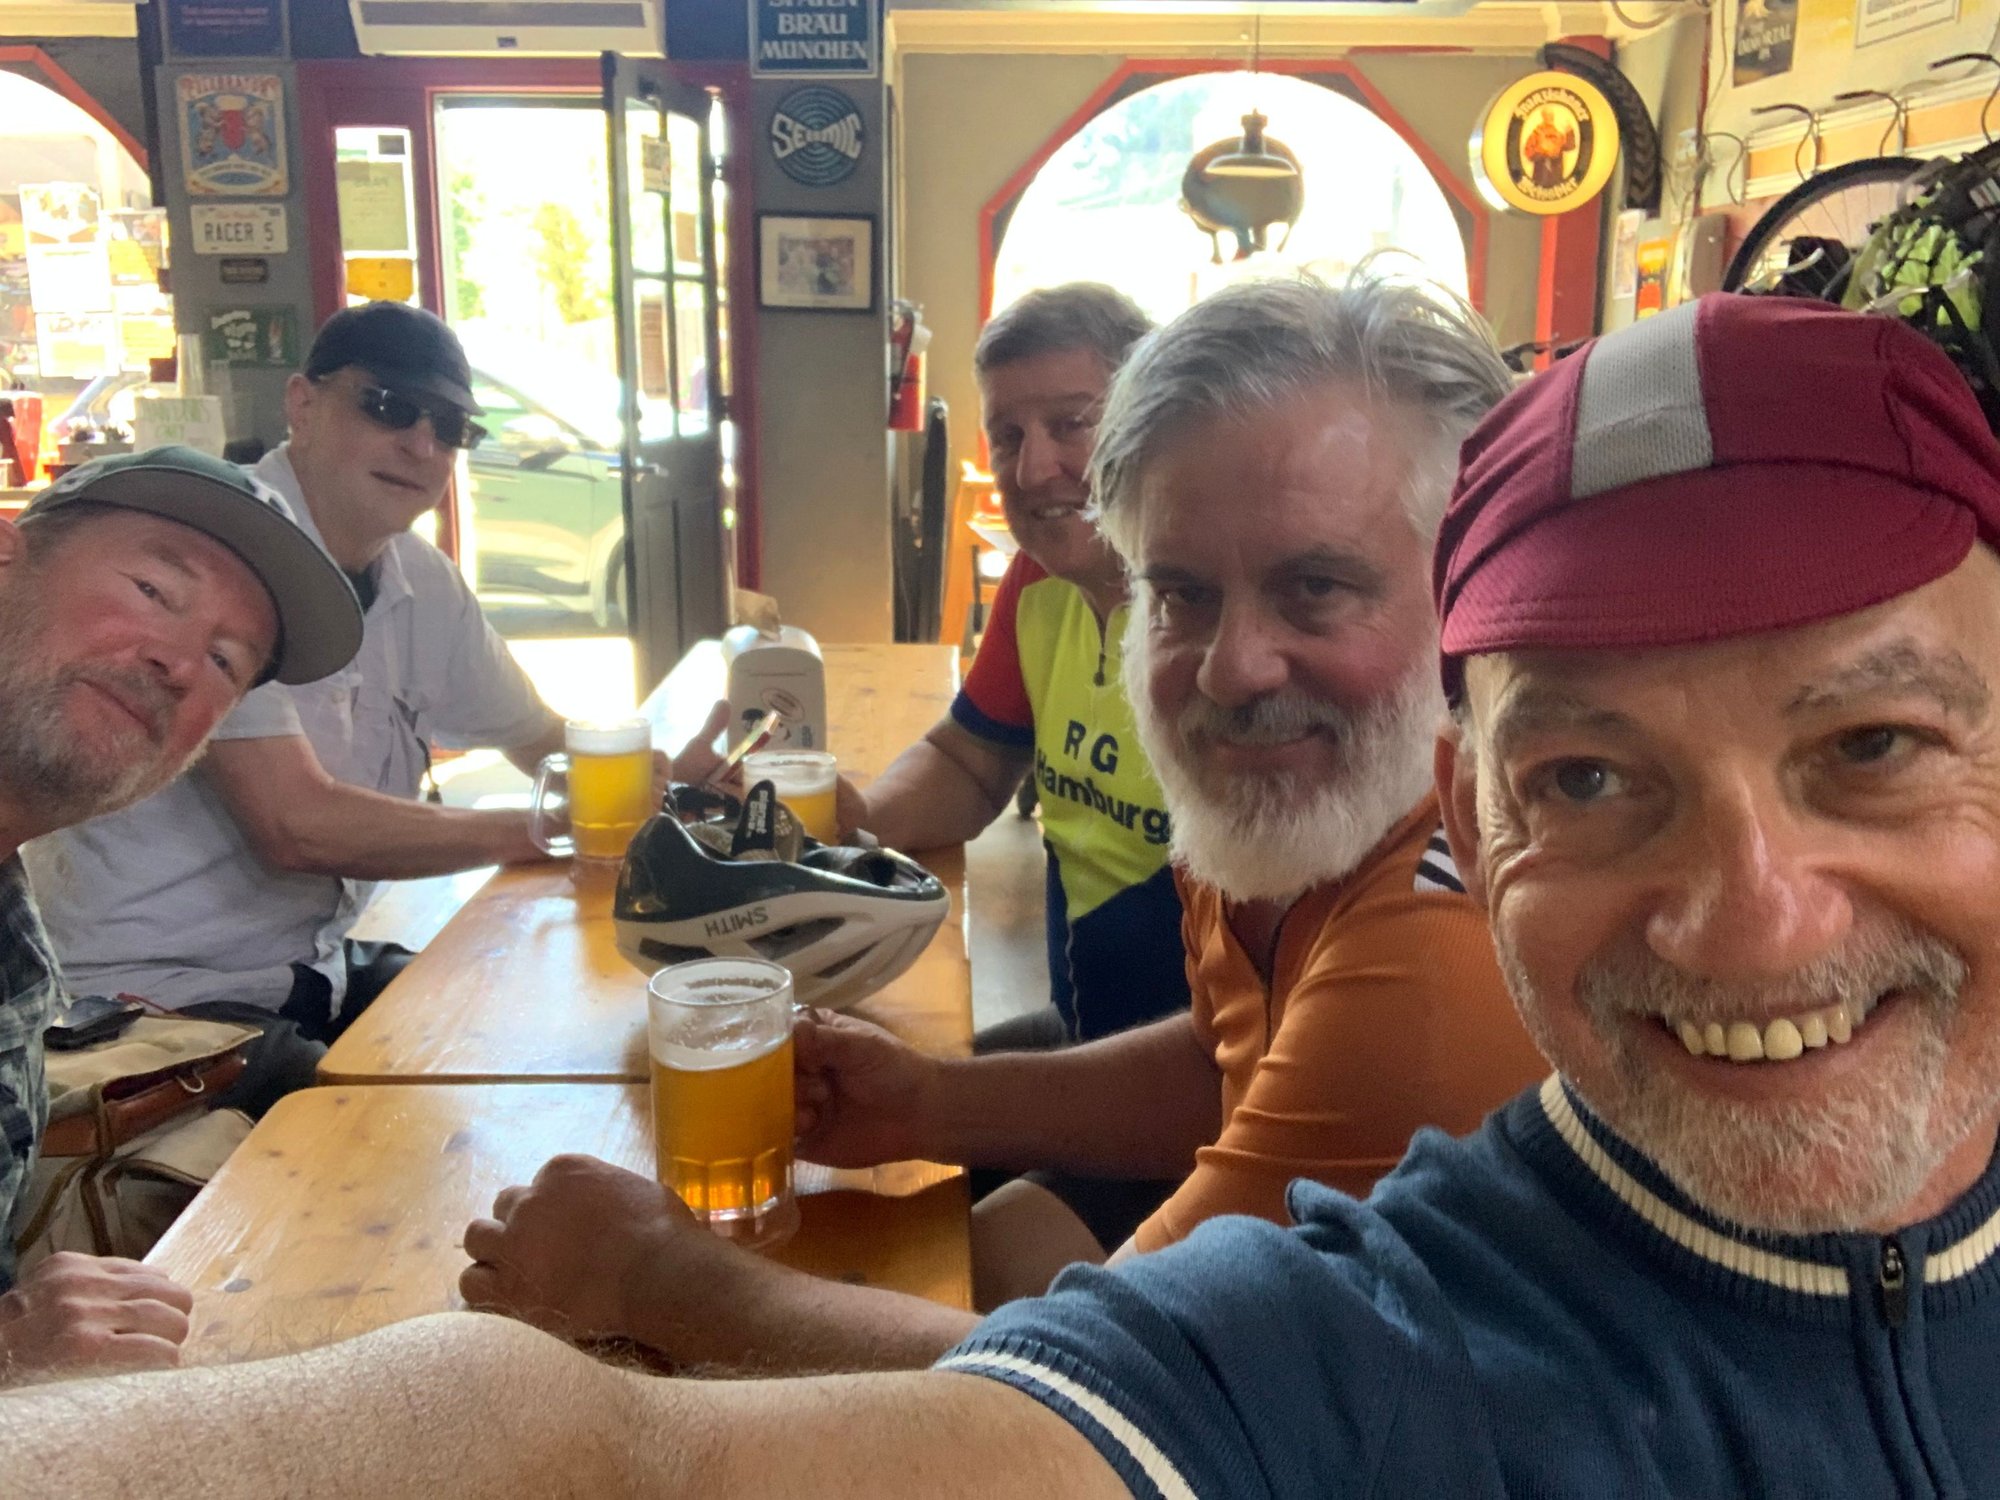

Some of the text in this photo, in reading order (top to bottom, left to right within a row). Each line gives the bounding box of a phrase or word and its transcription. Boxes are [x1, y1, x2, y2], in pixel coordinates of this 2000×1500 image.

[204, 222, 254, 242] RACER
[1064, 719, 1119, 775] R G
[1037, 748, 1173, 845] Hamburg
[704, 906, 769, 938] SMITH
